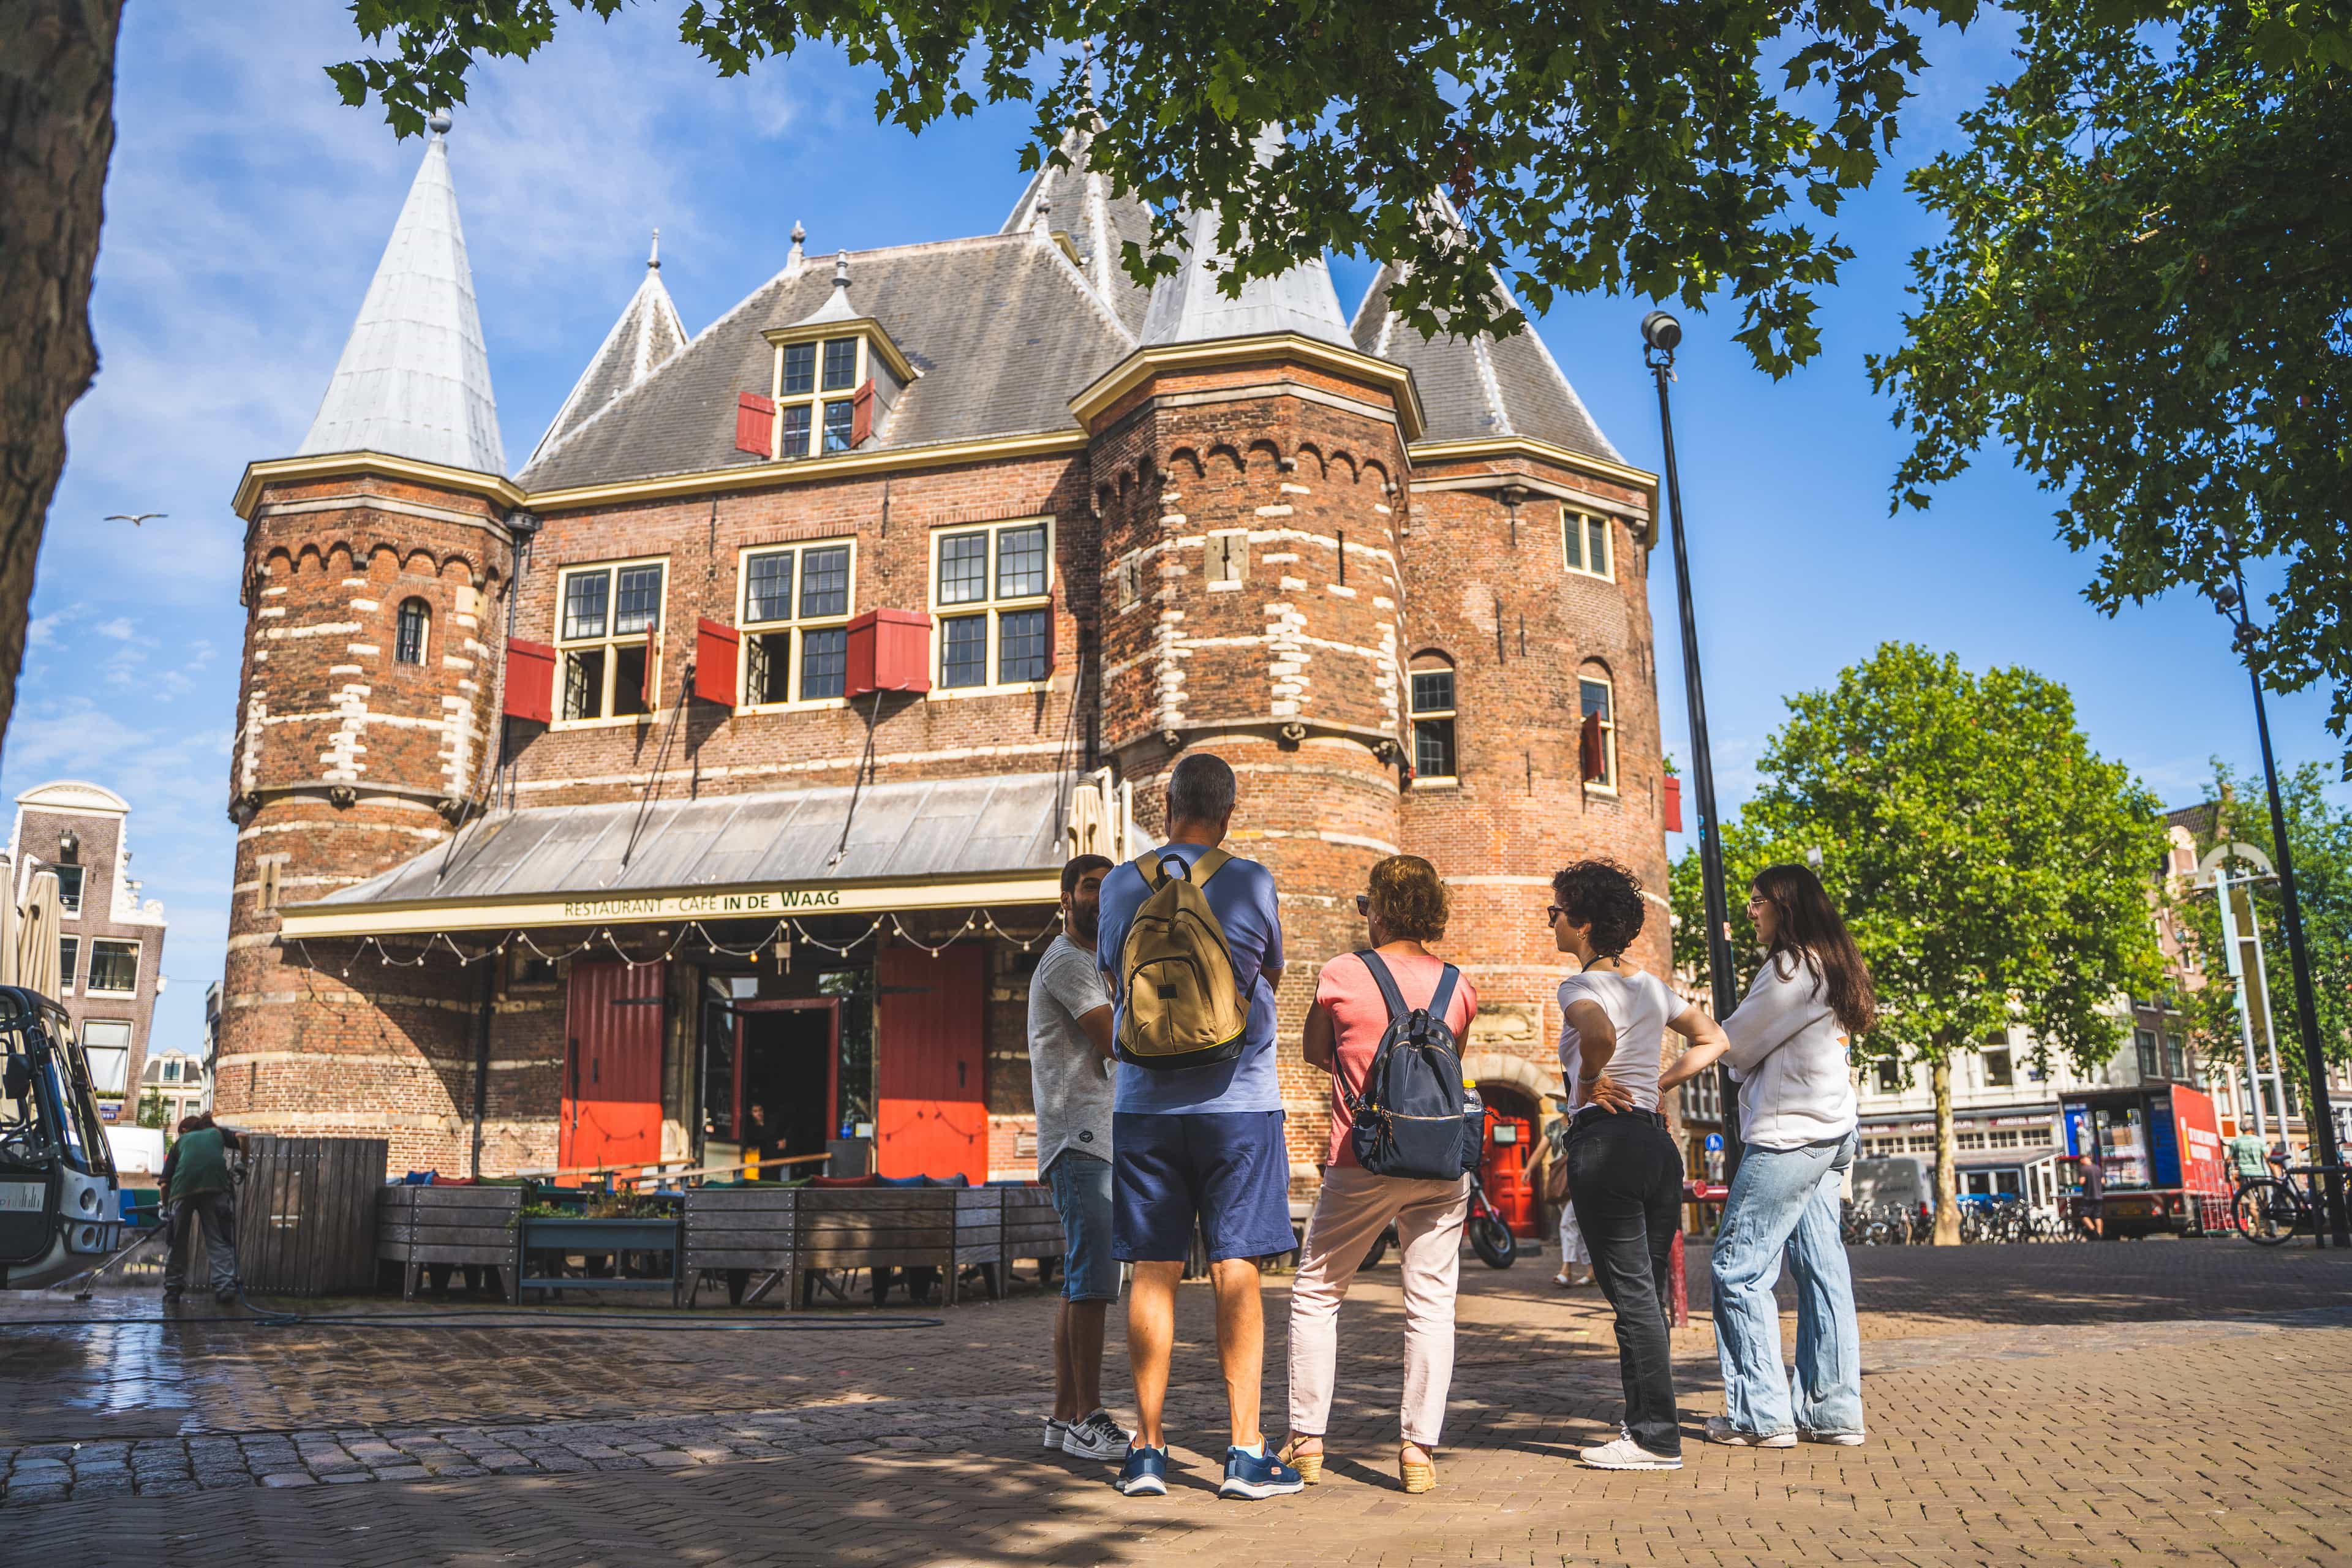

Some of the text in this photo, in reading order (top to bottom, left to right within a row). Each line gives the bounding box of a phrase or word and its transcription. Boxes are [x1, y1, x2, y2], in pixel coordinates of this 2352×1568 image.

[565, 897, 663, 916] RESTAURANT
[724, 896, 741, 910] IN
[748, 895, 769, 909] DE
